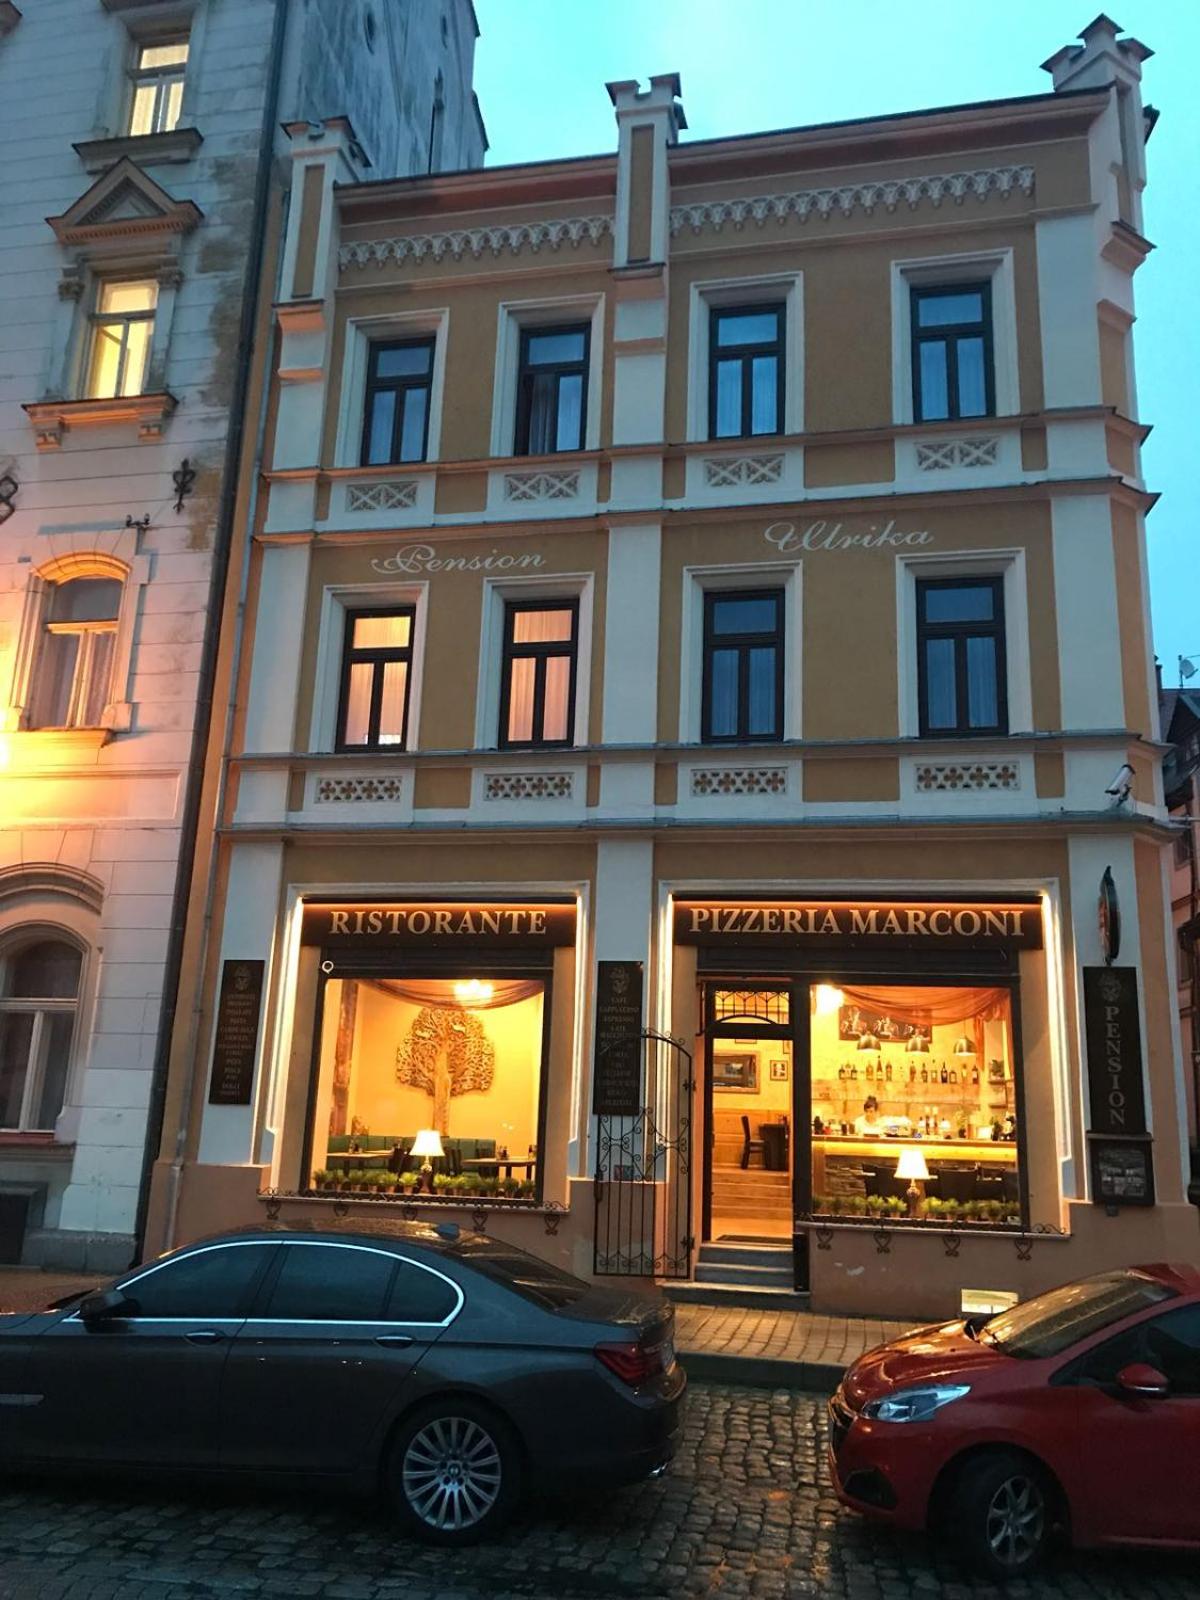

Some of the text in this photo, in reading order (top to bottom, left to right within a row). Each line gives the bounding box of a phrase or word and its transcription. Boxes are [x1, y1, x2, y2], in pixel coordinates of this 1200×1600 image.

[371, 519, 935, 575] Pension Ulrika
[329, 910, 547, 935] RISTORANTE
[688, 907, 1025, 937] PIZZERIA MARCONI
[1105, 1006, 1126, 1126] PENSION
